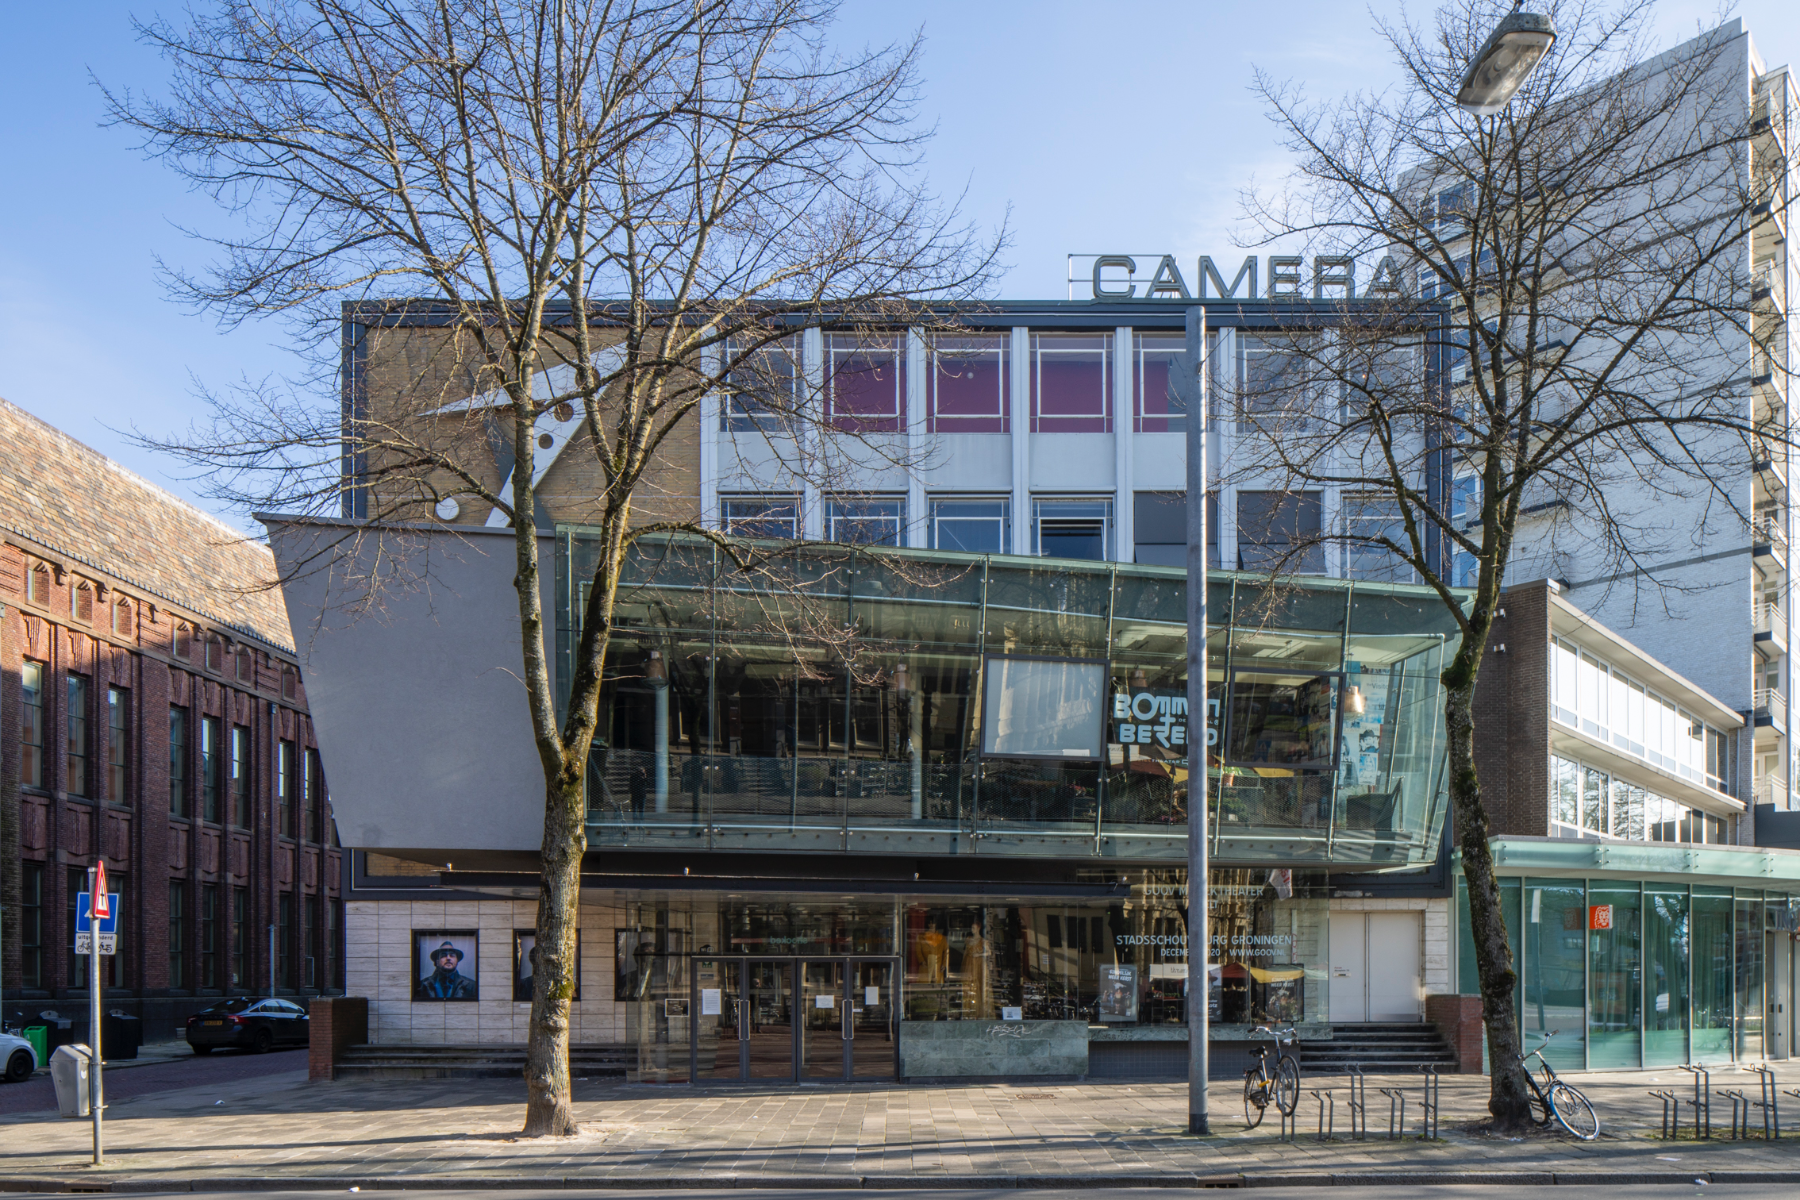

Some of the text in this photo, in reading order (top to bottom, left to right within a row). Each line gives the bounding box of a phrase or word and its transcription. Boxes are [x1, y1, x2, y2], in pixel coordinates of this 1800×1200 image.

[1092, 255, 1407, 299] CAMERA
[1113, 692, 1221, 720] BOMMN
[1119, 723, 1218, 748] BERED
[1144, 885, 1264, 896] GOOV MKTHEATER
[1116, 934, 1292, 945] STADSSCHOUURG GRONINGEN
[1207, 948, 1221, 957] 020
